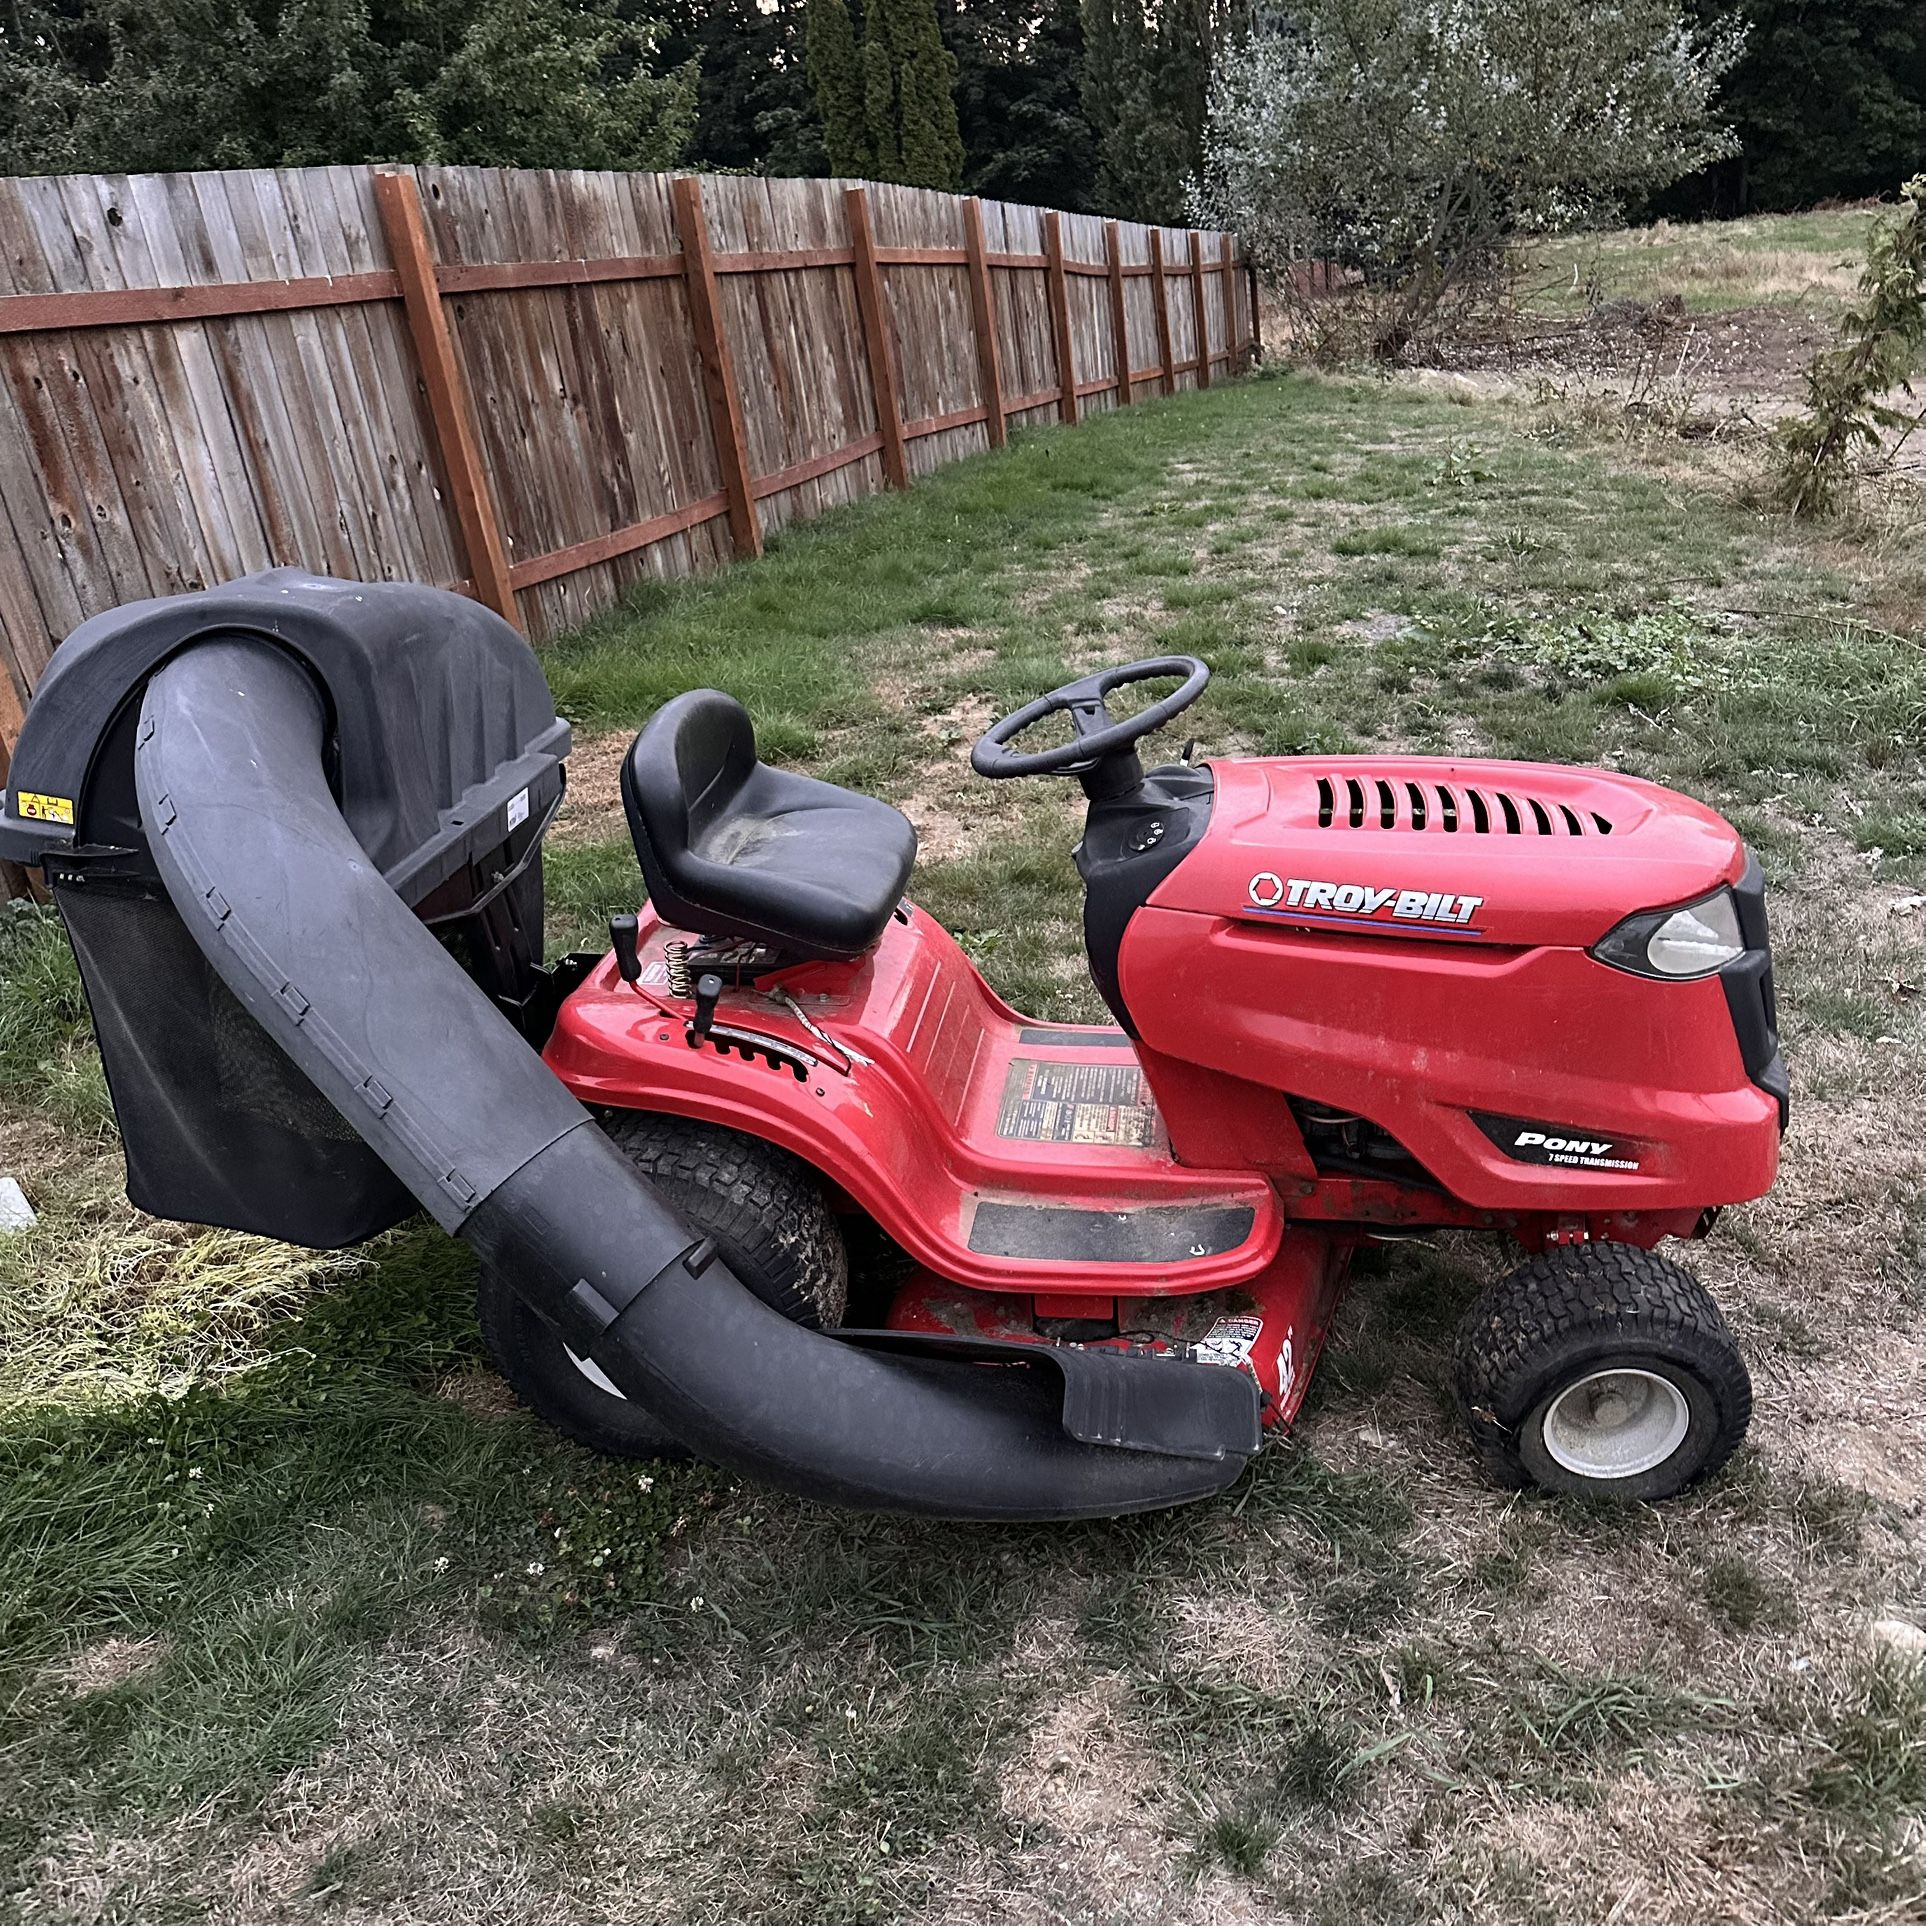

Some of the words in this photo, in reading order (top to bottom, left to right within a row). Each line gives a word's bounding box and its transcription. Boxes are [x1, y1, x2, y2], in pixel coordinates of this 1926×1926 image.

[1286, 878, 1484, 924] TROY-BILT
[1514, 1131, 1613, 1155] PONY
[1548, 1153, 1555, 1162] 7
[1554, 1154, 1579, 1164] SPEED
[1579, 1156, 1640, 1170] TRANSMISSION
